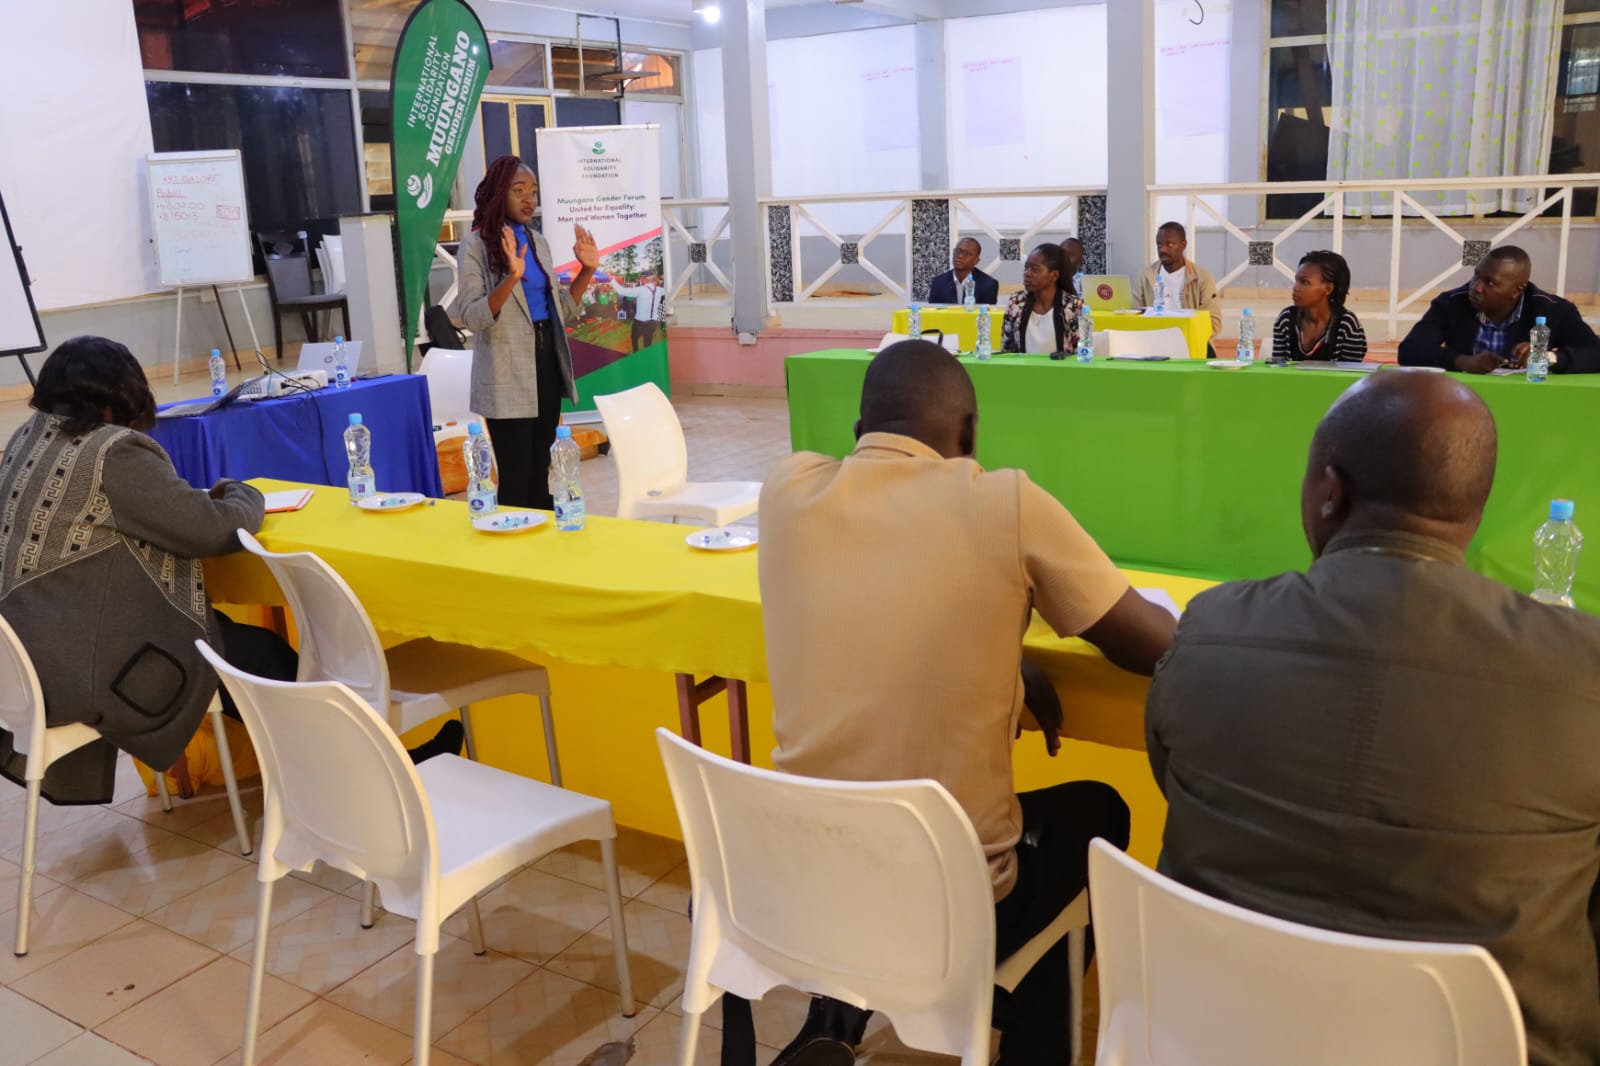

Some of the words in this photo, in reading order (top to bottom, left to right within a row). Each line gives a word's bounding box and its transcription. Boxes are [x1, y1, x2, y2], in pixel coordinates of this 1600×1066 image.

[407, 35, 438, 128] INTERNATIONAL
[418, 50, 442, 121] SOLIDARITY
[425, 52, 451, 130] FOUNDATION
[426, 31, 470, 167] MUUNGANO
[445, 103, 465, 155] GENDER
[460, 58, 477, 103] FORUM
[605, 203, 636, 212] Equality:
[616, 212, 647, 221] Together
